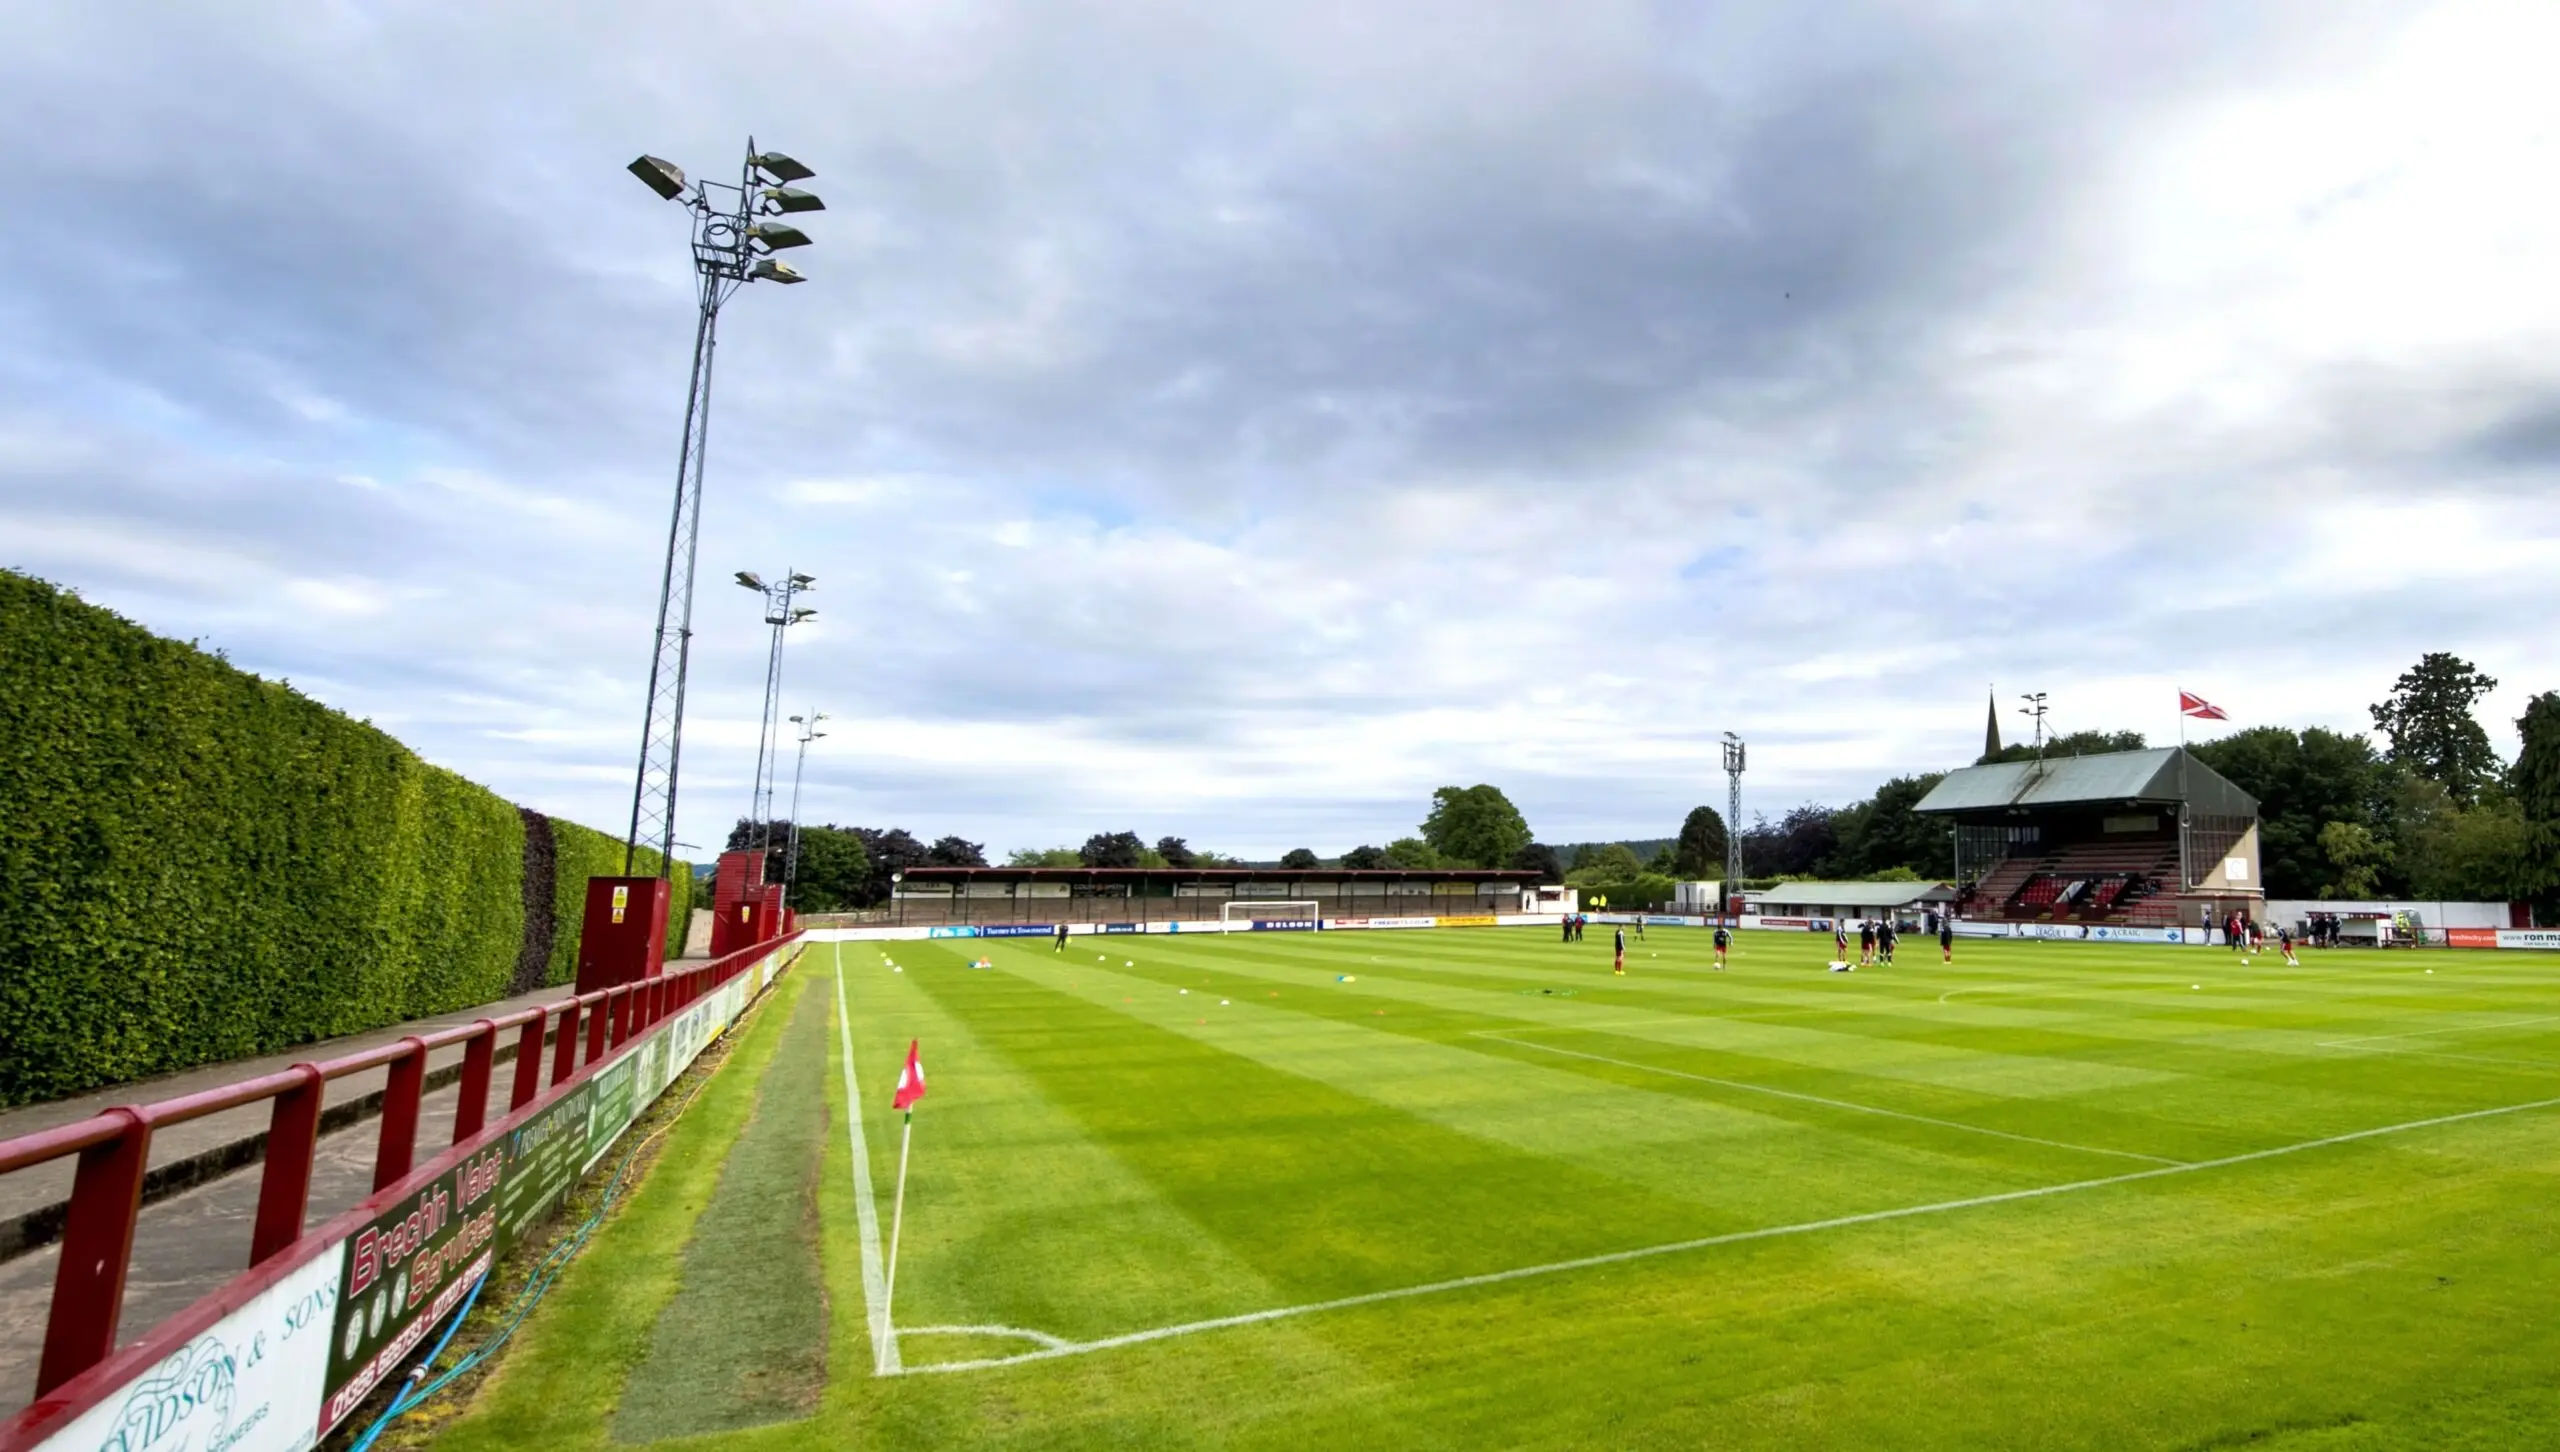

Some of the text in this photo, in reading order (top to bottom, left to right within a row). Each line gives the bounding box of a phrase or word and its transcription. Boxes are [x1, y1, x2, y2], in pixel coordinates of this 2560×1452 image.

[2524, 933, 2544, 941] ron
[348, 1184, 450, 1300] Brechin
[456, 1147, 502, 1214] Valet
[408, 1203, 496, 1310] Services
[246, 1330, 267, 1369] &
[281, 1276, 338, 1341] SONS
